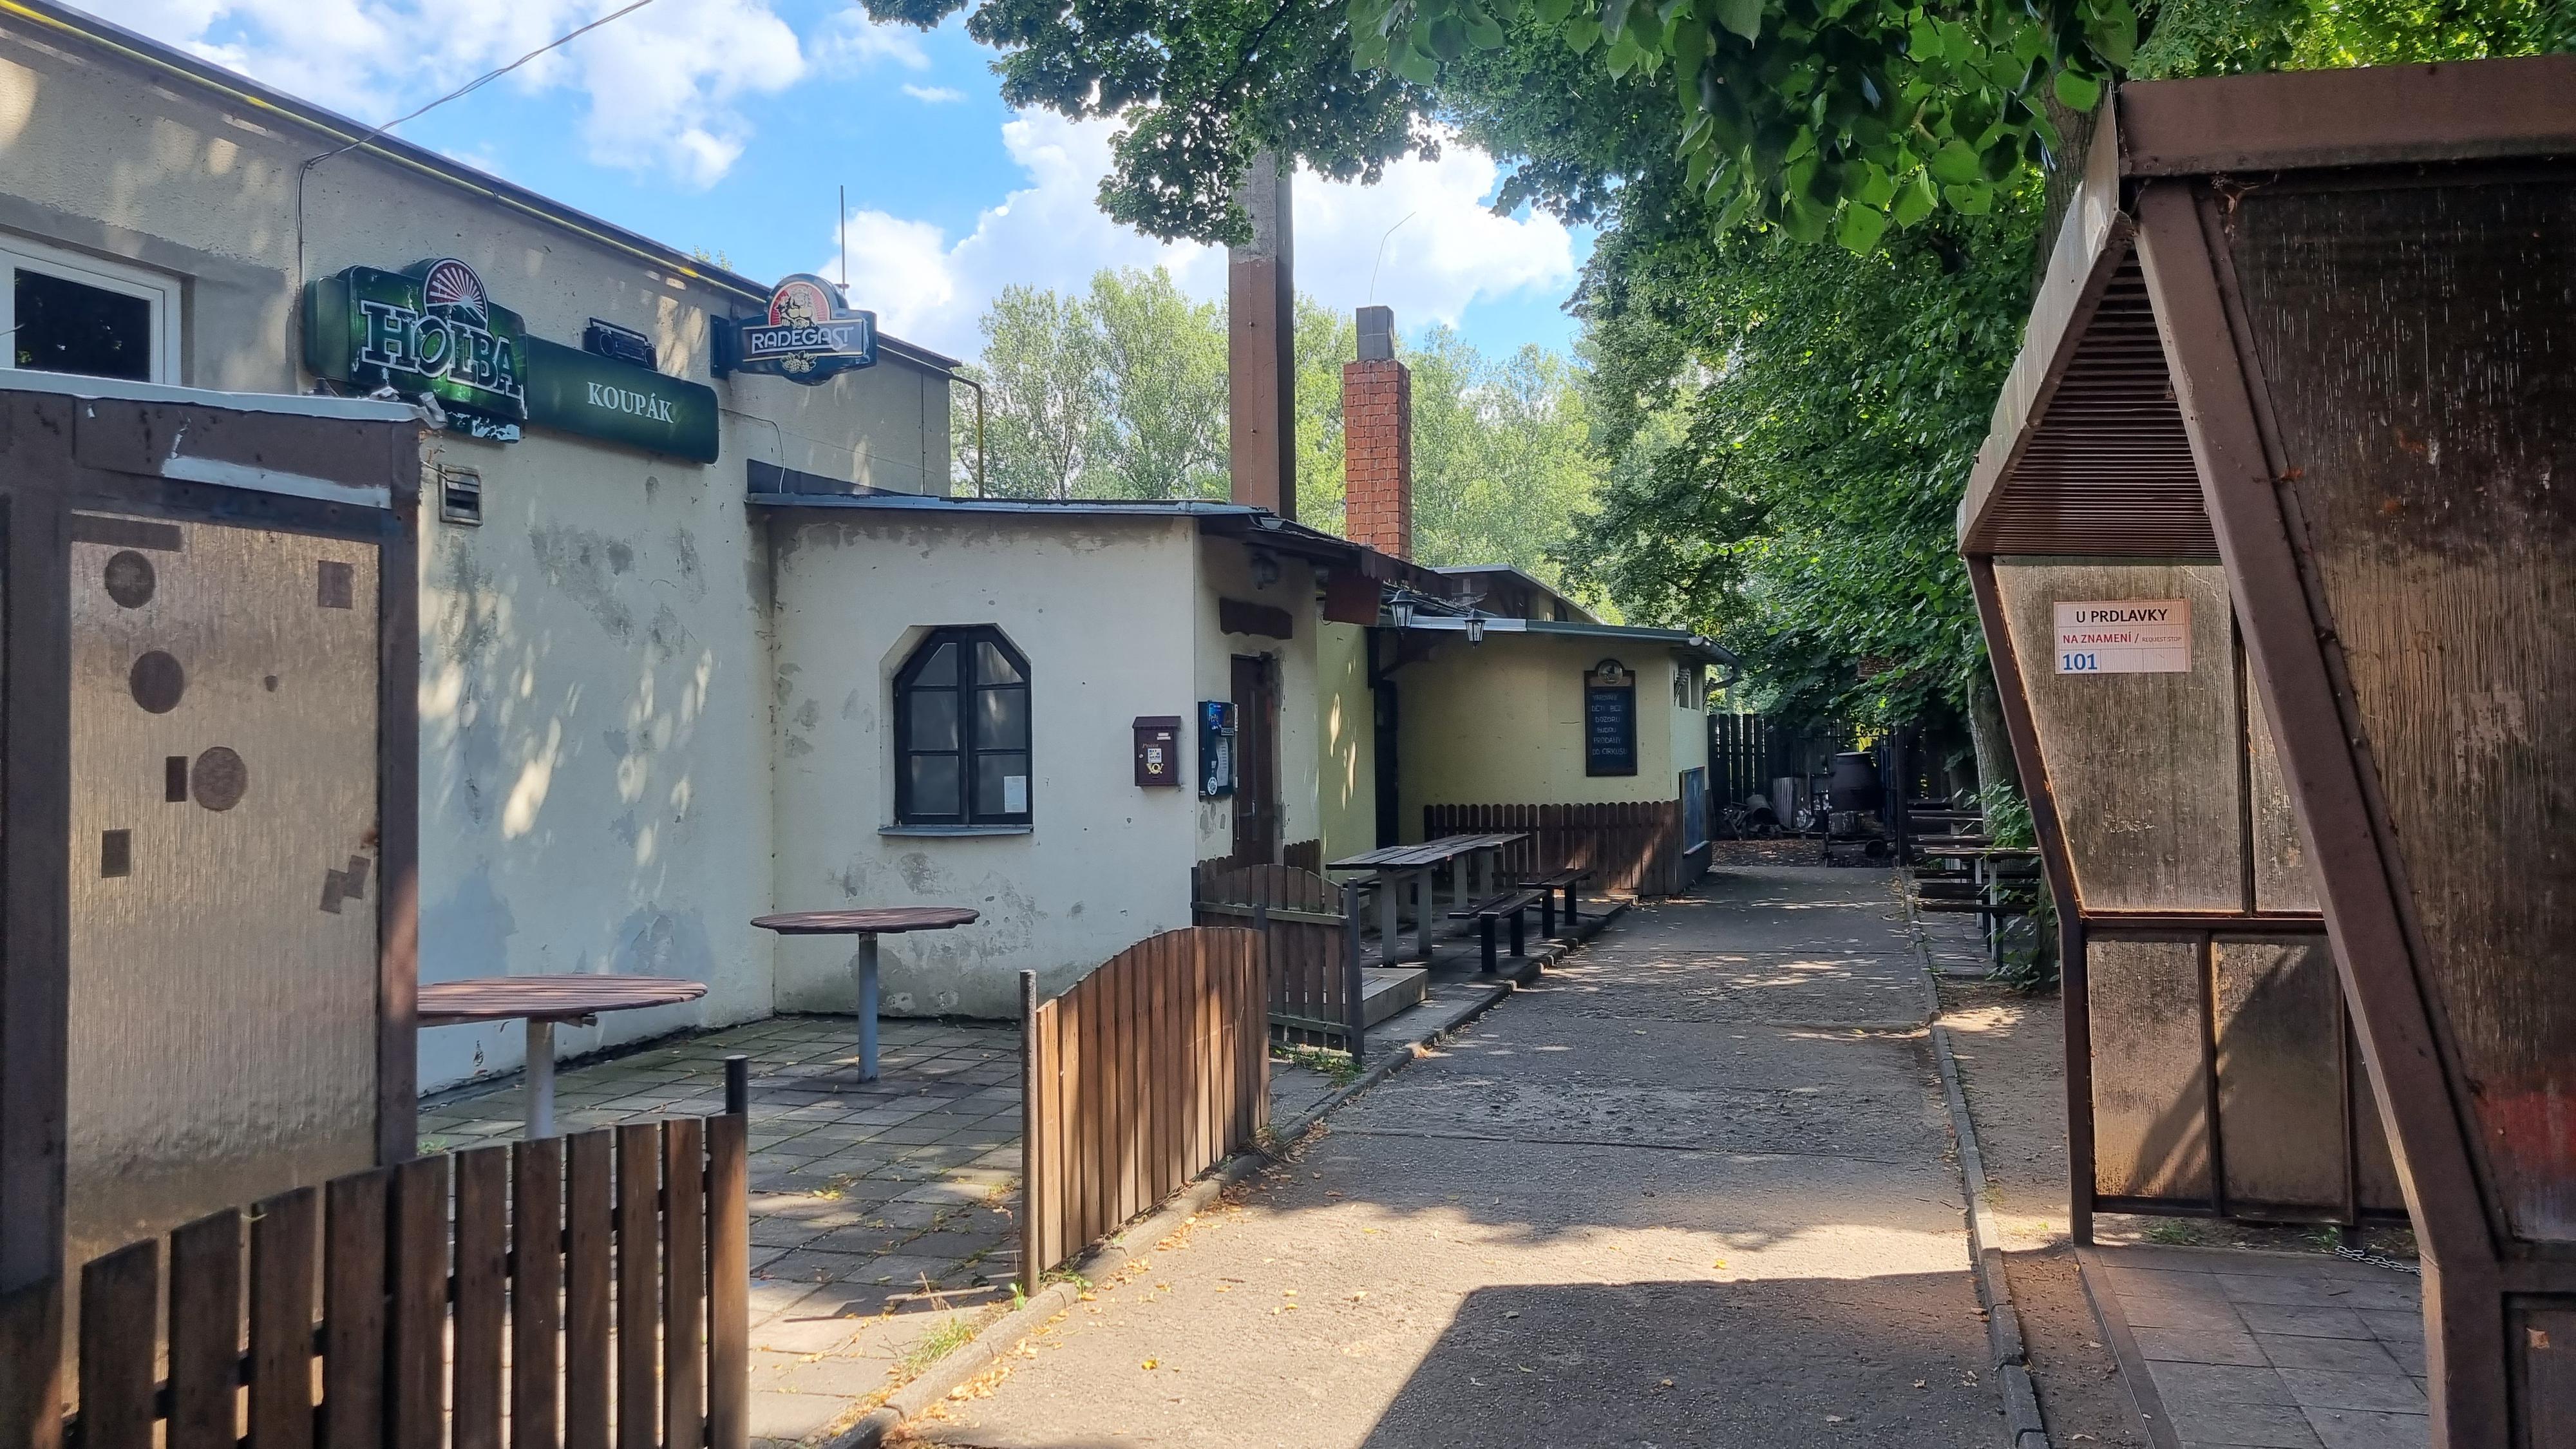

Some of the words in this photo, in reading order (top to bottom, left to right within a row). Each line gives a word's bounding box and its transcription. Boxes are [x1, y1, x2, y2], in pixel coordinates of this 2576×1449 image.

[361, 300, 524, 399] HOLBA
[752, 327, 854, 354] RADEGAST
[587, 381, 674, 424] KOUPÁK
[2076, 611, 2086, 623] U
[2091, 609, 2168, 623] PRDLAVKY
[2063, 635, 2078, 643] NA
[2081, 631, 2132, 643] ZNAMENÍ
[2063, 654, 2098, 670] 101
